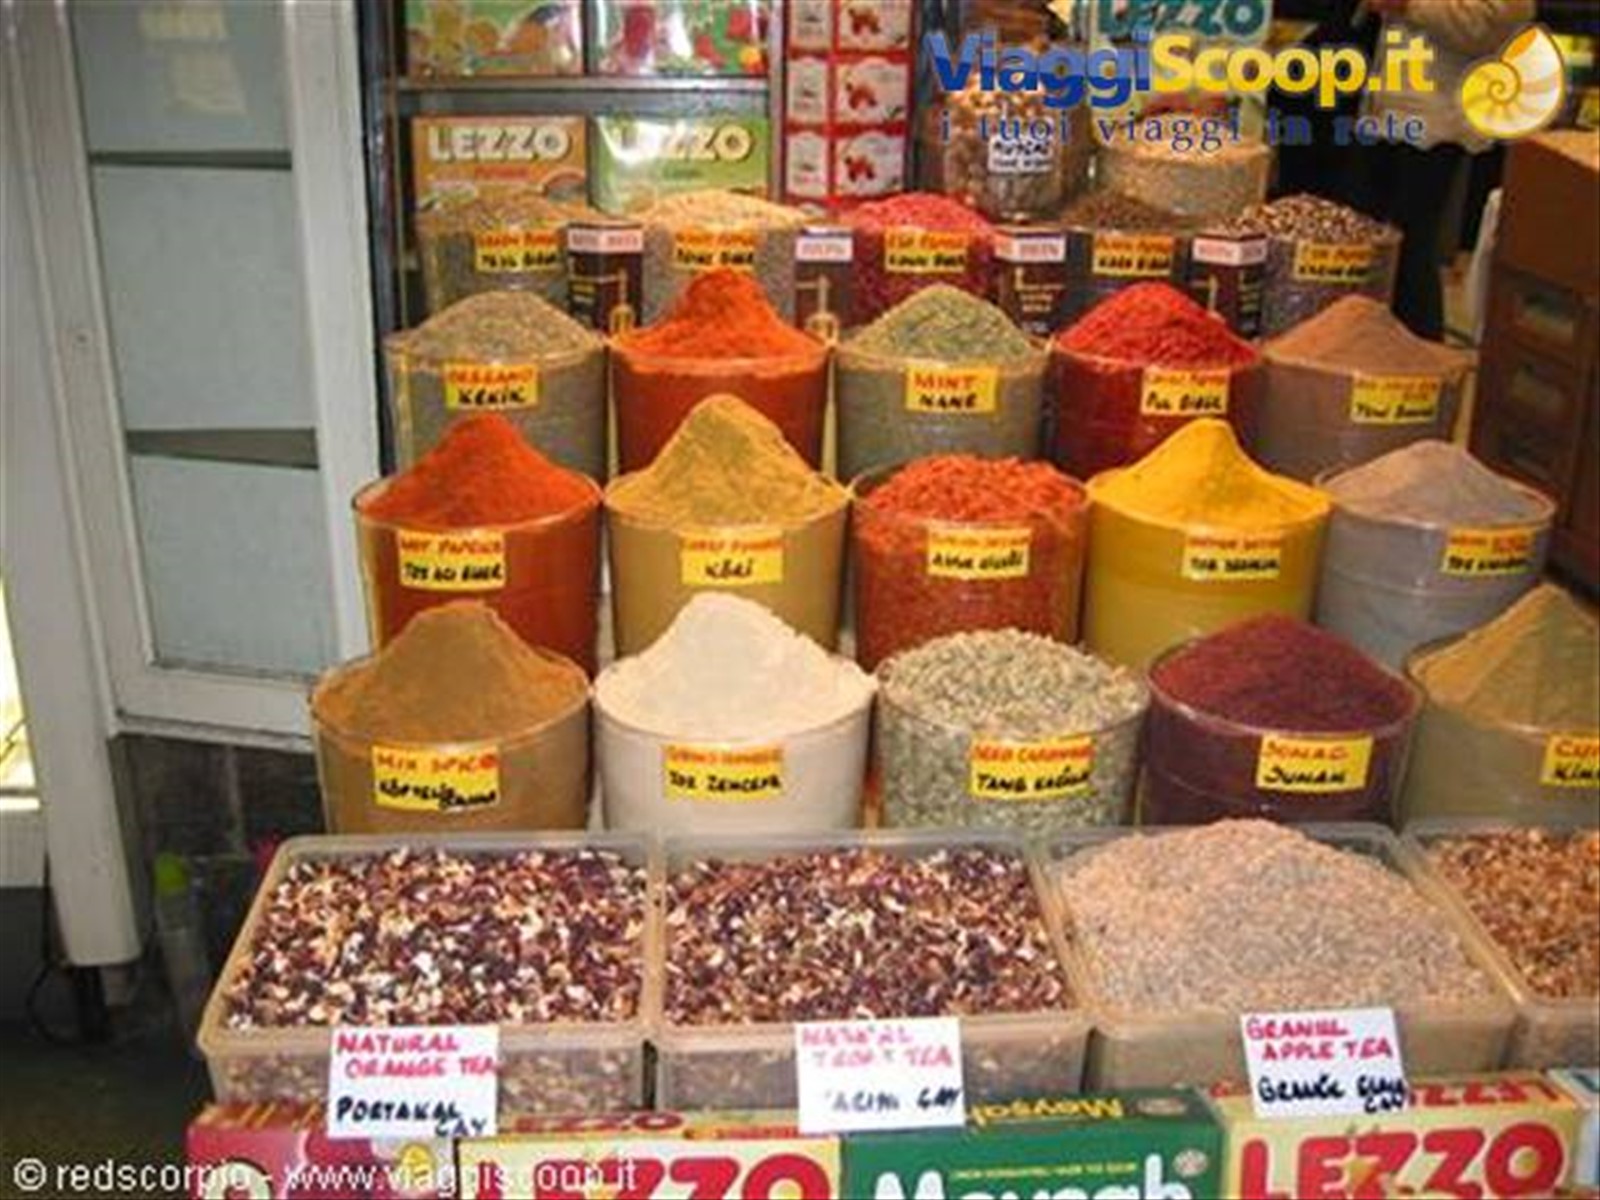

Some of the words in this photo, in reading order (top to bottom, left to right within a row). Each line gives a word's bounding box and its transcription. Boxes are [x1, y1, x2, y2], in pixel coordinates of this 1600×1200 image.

[427, 125, 571, 161] LEZZO
[914, 372, 977, 391] MINT
[337, 1032, 460, 1054] NATURAL
[1262, 1041, 1334, 1061] APPLE
[1343, 1036, 1393, 1059] TEA
[345, 1057, 446, 1079] ORANGE
[459, 1055, 499, 1075] TEA
[337, 1095, 461, 1122] PORTAKAL
[1239, 1122, 1564, 1200] LEZZO
